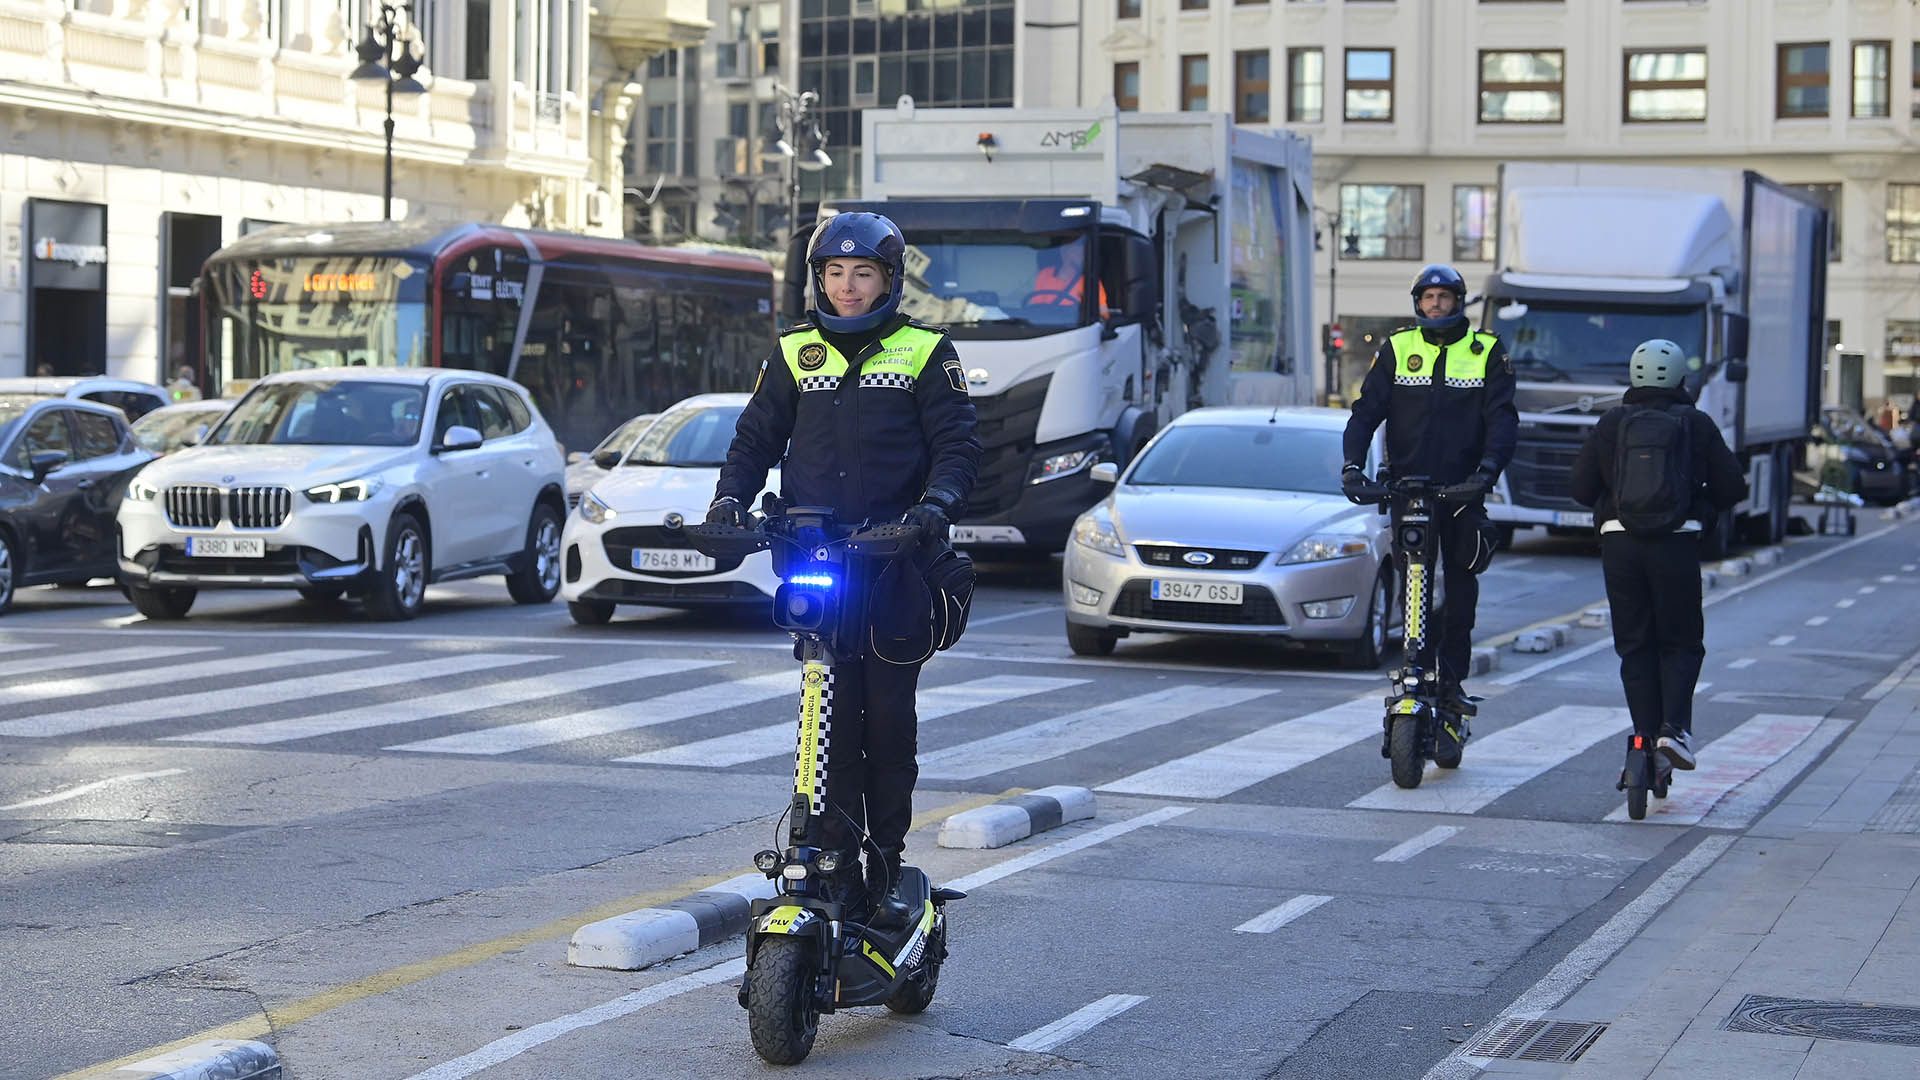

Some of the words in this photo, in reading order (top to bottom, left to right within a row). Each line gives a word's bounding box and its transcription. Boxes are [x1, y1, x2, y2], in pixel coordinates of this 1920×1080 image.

[1041, 130, 1089, 146] AMS
[251, 270, 266, 298] 6
[883, 346, 913, 354] OLICIA
[233, 540, 258, 553] MRN
[642, 552, 678, 567] 7648
[1163, 582, 1202, 598] 3947
[1208, 584, 1239, 601] GSJ
[804, 732, 812, 755] LOCAL
[802, 757, 811, 787] POLICIA
[770, 918, 790, 926] PLV
